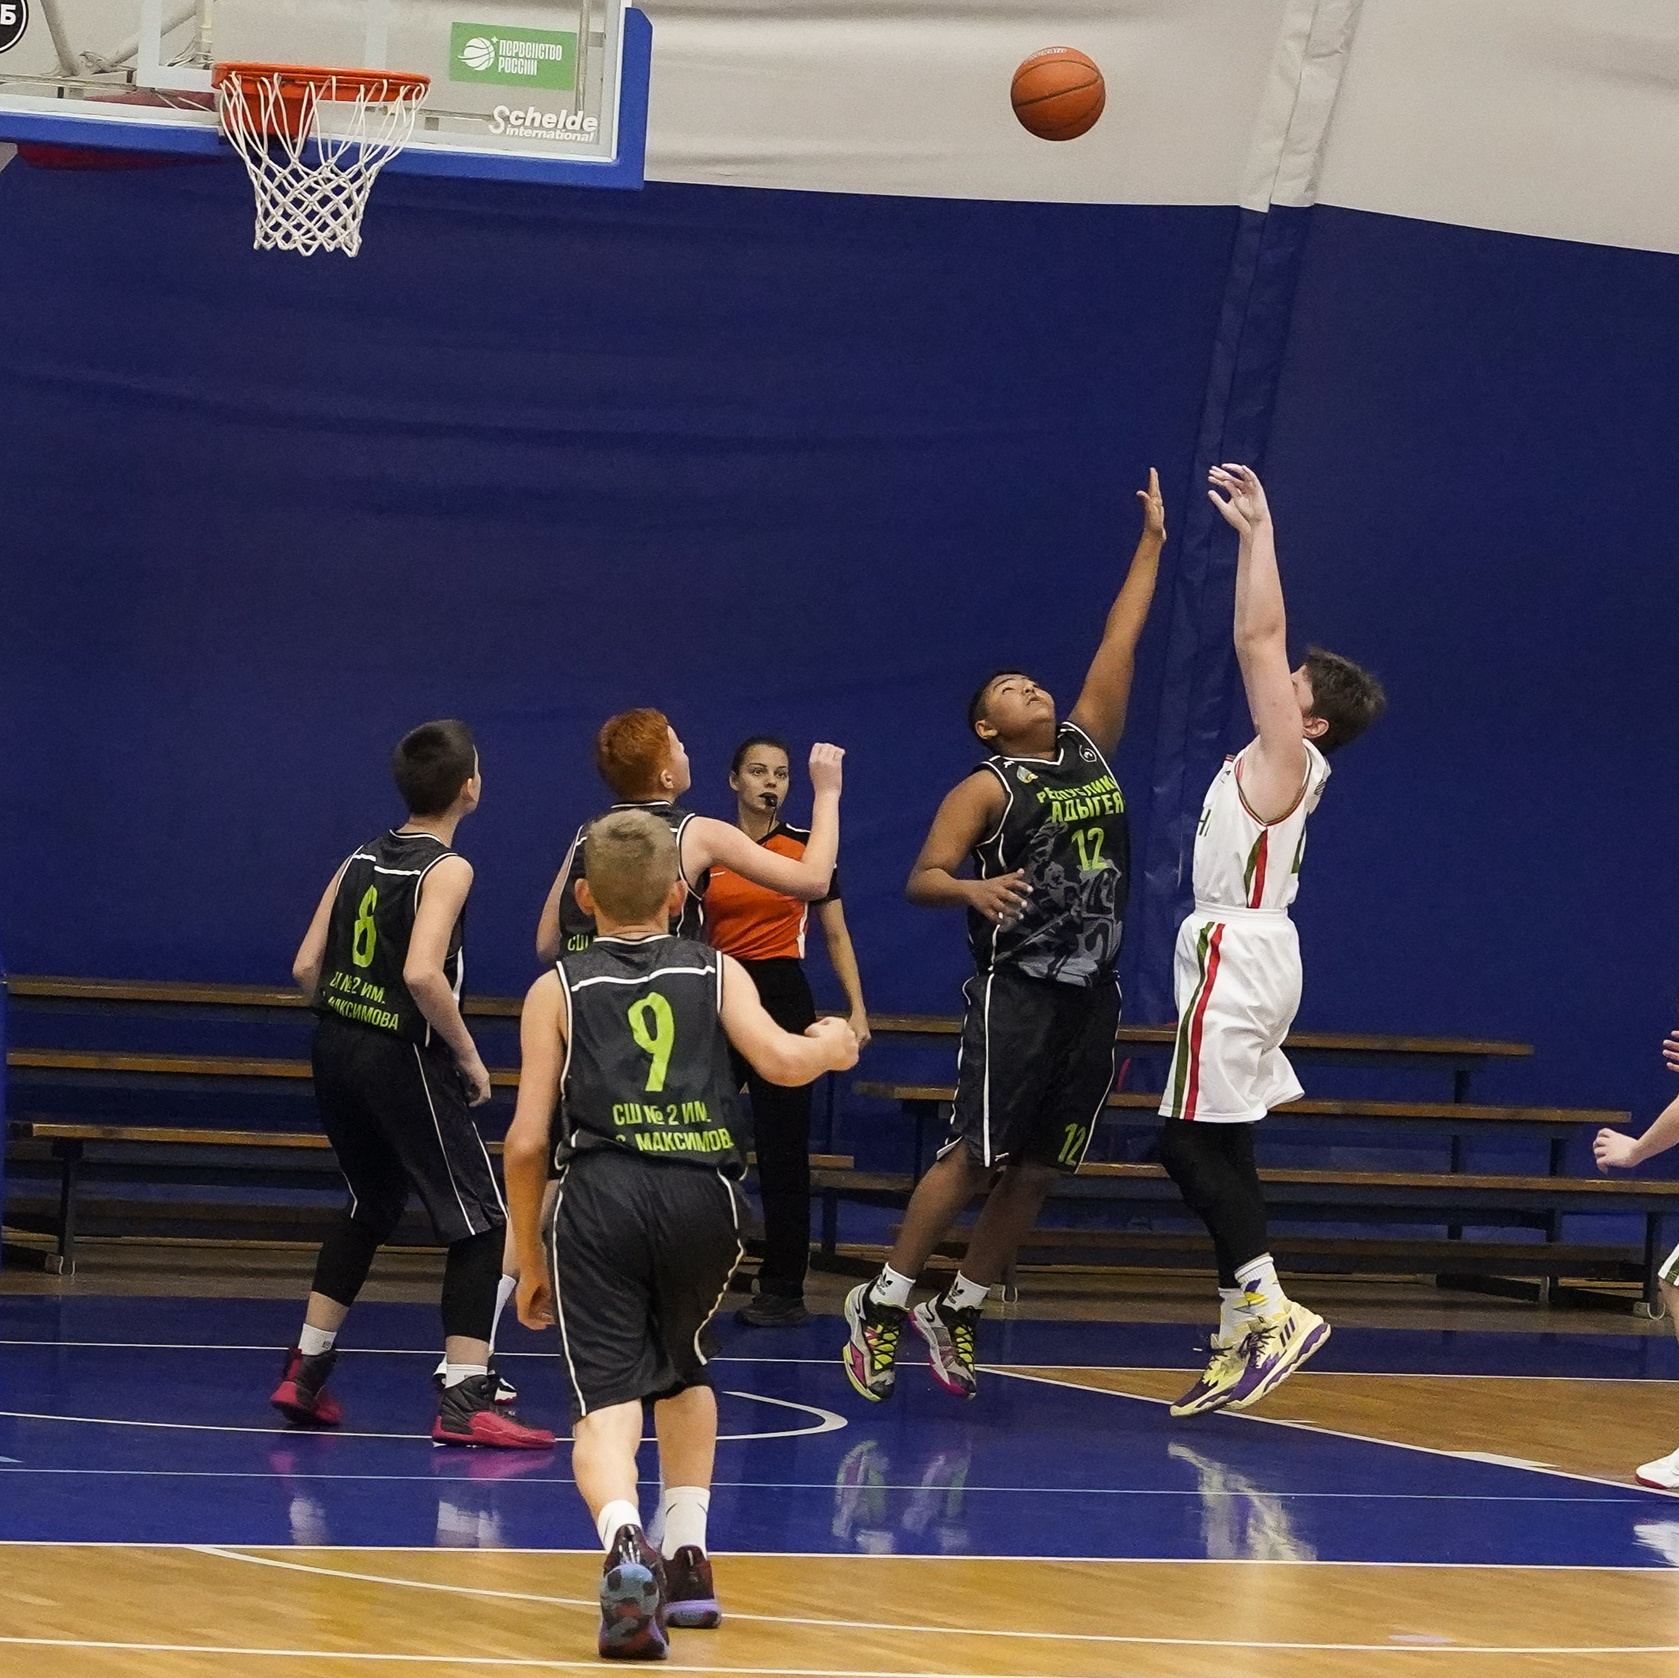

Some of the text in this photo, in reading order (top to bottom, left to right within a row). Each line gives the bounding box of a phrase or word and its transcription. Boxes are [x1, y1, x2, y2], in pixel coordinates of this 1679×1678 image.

[498, 56, 538, 76] РОССИИ
[488, 105, 599, 134] Schelde
[506, 124, 595, 142] international
[1051, 791, 1125, 824] АДЫГЕЯ
[1071, 827, 1108, 871] 12
[360, 982, 386, 1005] ИМ.
[627, 991, 675, 1092] 9
[612, 1102, 643, 1126] СШ
[643, 1105, 666, 1125] №
[666, 1104, 680, 1126] 2
[634, 1127, 735, 1153] МАКСИМОВ
[1058, 1123, 1086, 1166] 12
